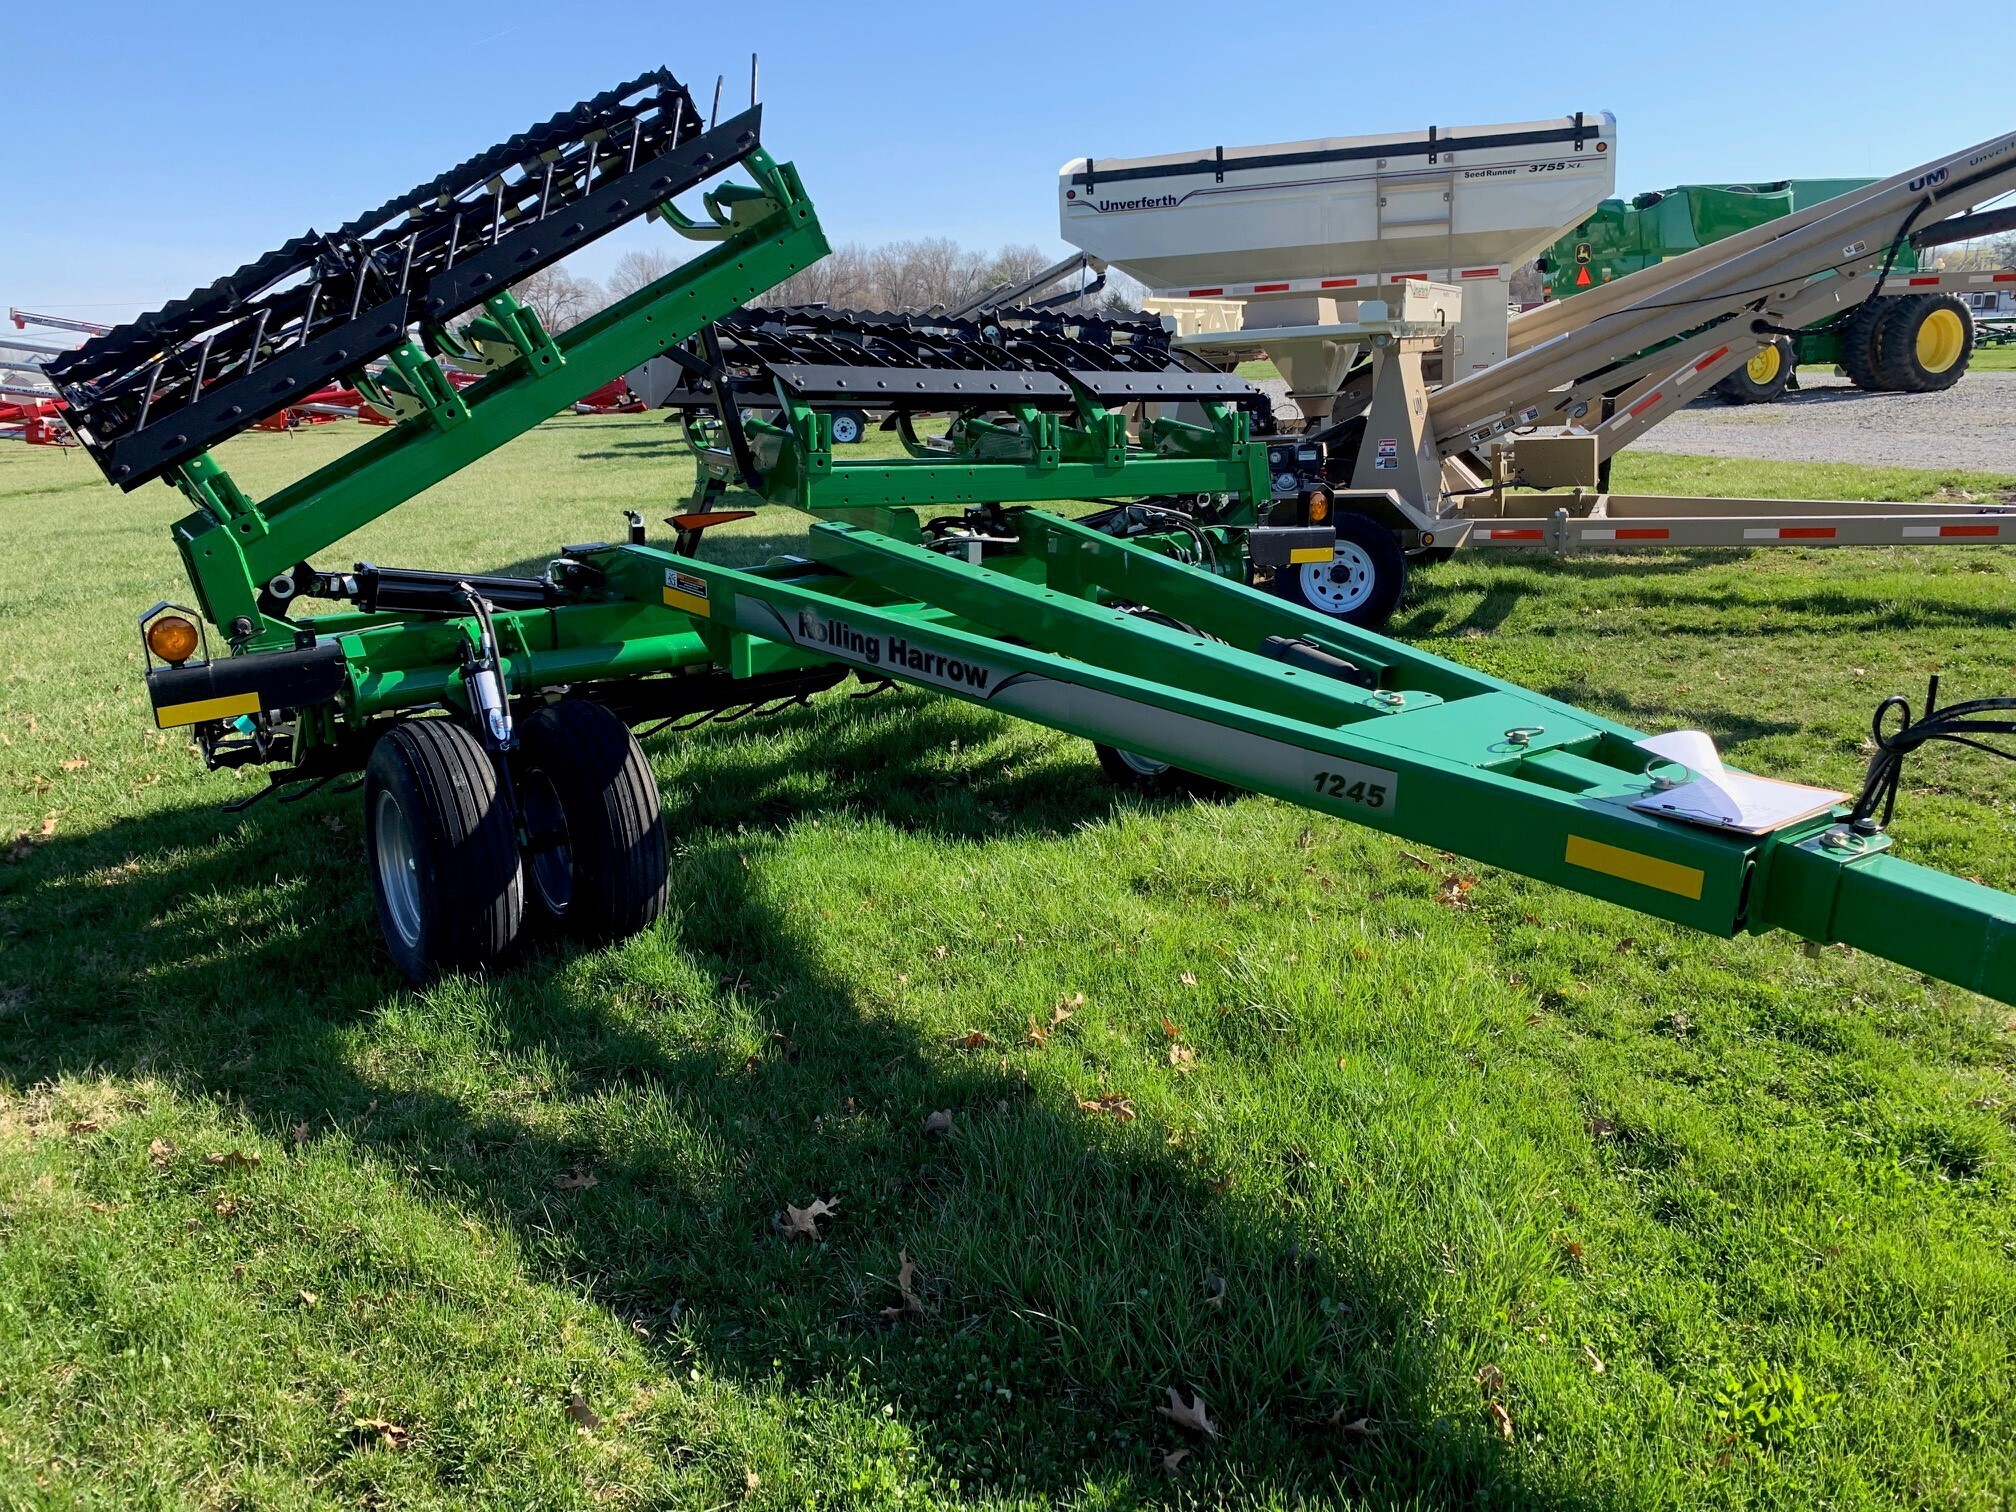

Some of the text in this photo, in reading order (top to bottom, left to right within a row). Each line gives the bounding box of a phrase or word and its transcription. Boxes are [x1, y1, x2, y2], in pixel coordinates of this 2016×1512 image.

[1464, 168, 1516, 179] Seed Runner
[1528, 162, 1565, 173] 3755
[1908, 166, 1947, 192] UM
[1100, 194, 1177, 212] Unverferth
[799, 610, 989, 690] Rolling Harrow
[1313, 771, 1387, 808] 1245
